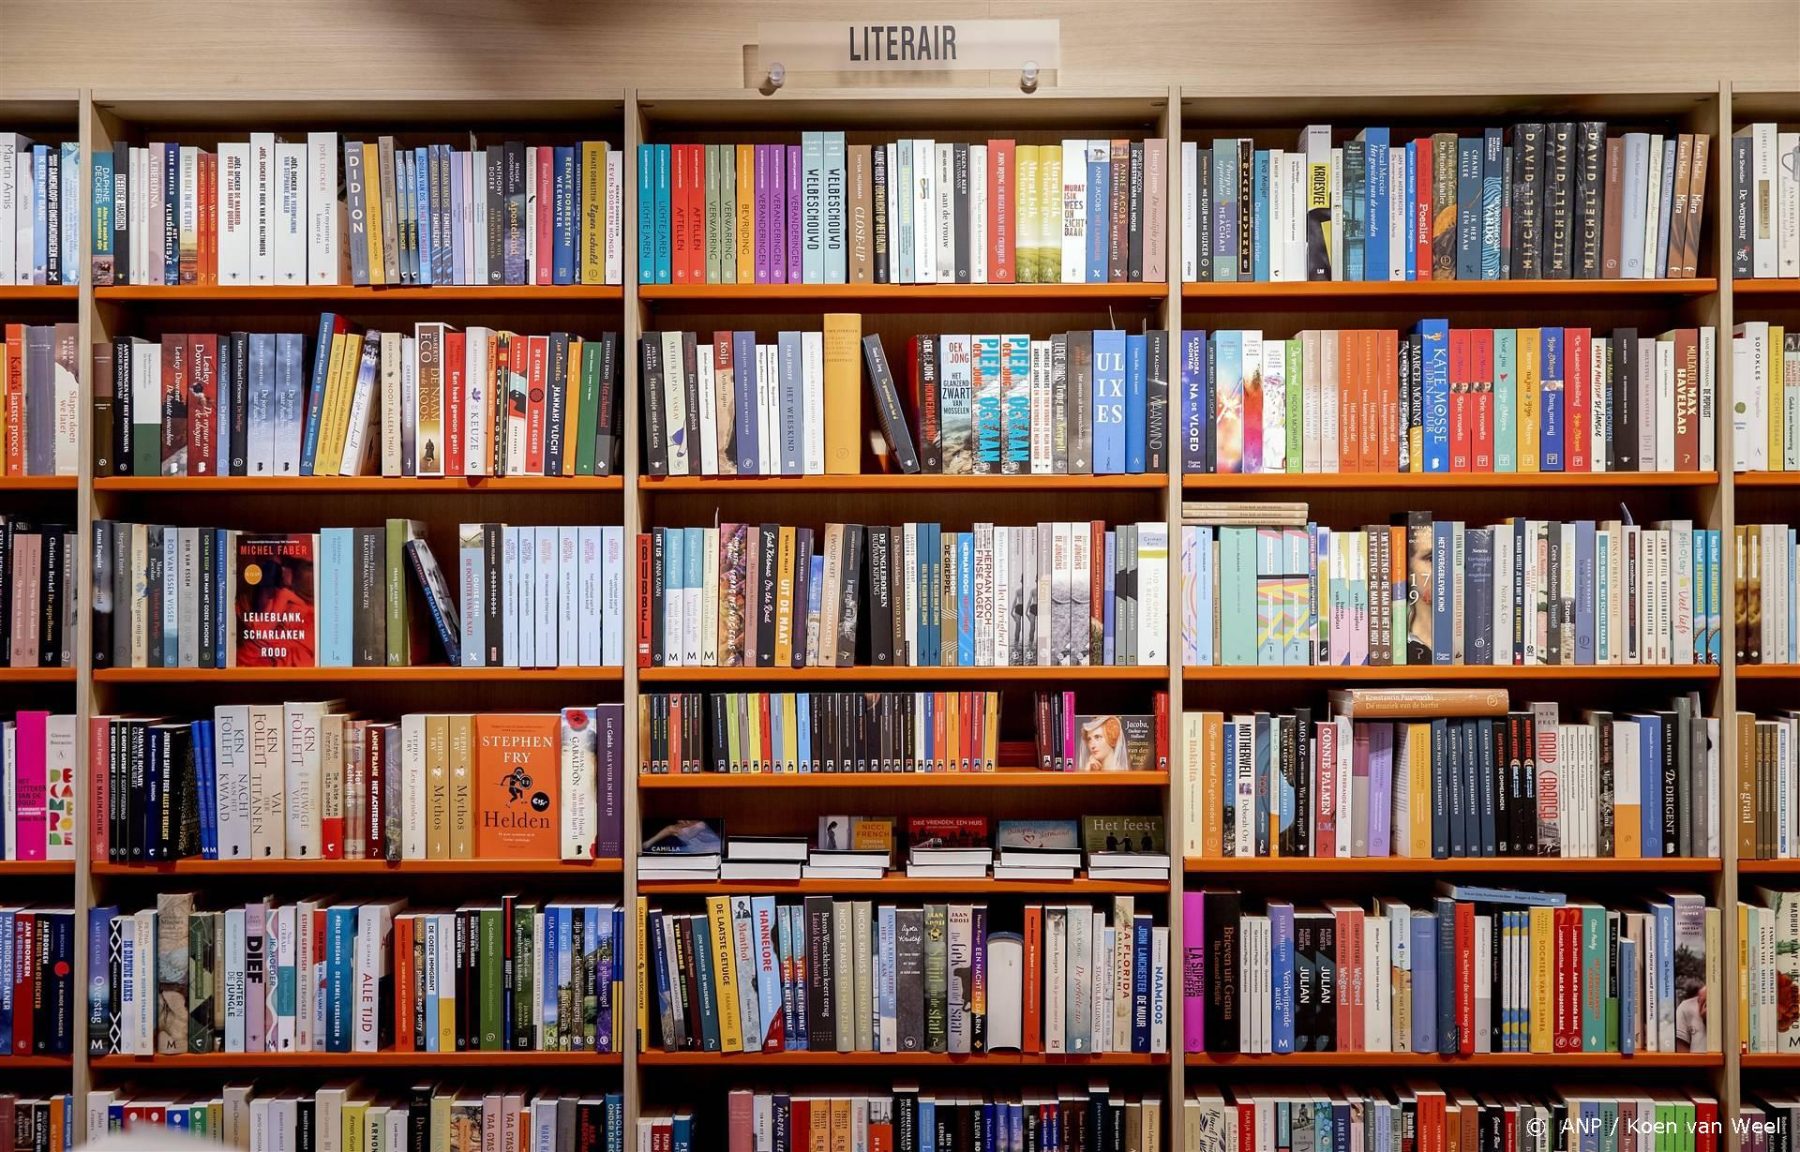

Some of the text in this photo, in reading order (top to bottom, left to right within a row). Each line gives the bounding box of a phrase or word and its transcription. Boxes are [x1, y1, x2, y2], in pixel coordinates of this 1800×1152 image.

[850, 25, 957, 61] LITERAIR
[258, 147, 266, 161] JOËL
[258, 162, 266, 181] DICKER
[95, 165, 103, 204] DECKERS
[102, 167, 110, 202] DAPHNE
[150, 154, 158, 208] ALBERDINA
[349, 156, 362, 234] DIDION
[555, 176, 564, 228] WEERWATER
[563, 157, 572, 247] RENATE DORRESTEIN
[1313, 166, 1327, 205] KROESVEE
[1523, 133, 1535, 269] DAVID MITCHELL
[1554, 132, 1567, 269] DAVID MITCHELL
[1584, 131, 1598, 269] DAVID MITCHELL
[1675, 194, 1686, 213] Mitra
[1690, 194, 1701, 213] Mitra
[709, 200, 718, 260] VERWARRING
[724, 200, 733, 260] VERWARRING
[758, 193, 767, 266] VERANDERINGEN
[773, 193, 782, 266] VERANDERINGEN
[790, 195, 800, 267] VERANDERINGEN
[806, 168, 819, 250] WELBESCHOUWD
[827, 168, 841, 250] WELBESCHOUWD
[855, 206, 865, 261] CLOSE-UP
[1419, 203, 1429, 244] Poeslief
[164, 203, 174, 265] VLINDERMEISJE
[194, 344, 204, 382] Downer
[201, 356, 213, 385] Lesley
[420, 332, 432, 363] ECO
[978, 338, 1000, 376] PIER
[1007, 338, 1029, 376] PIER
[1096, 353, 1124, 372] UL
[419, 386, 429, 421] ROOS
[430, 368, 441, 421] DE NAAM
[942, 387, 970, 399] ZWART
[1096, 379, 1124, 397] IX
[1412, 345, 1423, 426] MARCEL MÖRING
[1434, 348, 1447, 444] KATE MOSSE
[1676, 368, 1687, 435] HAVELAAR
[1687, 345, 1696, 415] MULTATULI MAX
[10, 356, 21, 456] Kafka's laatste proces
[450, 404, 458, 432] gewoon
[978, 396, 1000, 462] OCEAAN
[1007, 396, 1029, 462] OCEAAN
[1096, 404, 1122, 424] ES
[1189, 384, 1199, 451] NA DE VLOED
[451, 435, 459, 454] gezin
[470, 412, 480, 450] KEUZE
[240, 545, 307, 556] MICHEL FABER
[976, 550, 984, 618] FINSE DAGEN
[243, 611, 305, 623] LELIEBLANK,
[243, 630, 305, 640] SCHARLAKEN
[779, 579, 790, 645] UIT DE MAAT
[261, 648, 287, 657] ROOD
[221, 715, 234, 767] FOLLETT
[234, 729, 244, 753] KEN
[253, 714, 266, 768] FOLLETT
[268, 729, 278, 753] KEN
[291, 712, 304, 766] FOLLETT
[304, 726, 315, 752] KEN
[482, 736, 553, 747] STEPHEN
[503, 753, 530, 763] FRY
[571, 736, 581, 786] GABALDON
[1238, 724, 1252, 779] MOTHERWELL
[238, 773, 248, 819] NACHT
[1321, 728, 1331, 815] CONNIE PALMEN
[1539, 732, 1557, 819] MAUP CARANSA
[219, 773, 229, 822] KWAAD
[252, 774, 262, 834] TITANEN
[271, 792, 281, 816] VAL
[433, 785, 444, 831] Mythos
[456, 785, 467, 831] Mythos
[483, 811, 549, 829] Helden
[1665, 769, 1676, 835] De DIRIGENT
[1742, 782, 1754, 824] de graal
[1094, 818, 1156, 831] Het feest
[247, 935, 263, 984] DIEF
[716, 904, 730, 986] DE LAATSTE GETUIGE
[759, 910, 772, 972] HANNELORE
[821, 912, 831, 1017] Baron Wenckheim keert terug
[92, 976, 105, 1024] Overstag
[228, 972, 234, 981] DE
[1137, 926, 1147, 1027] JOHN LANCHESTER DE MUUR
[1154, 967, 1163, 1024] NAAMLOOS
[1275, 987, 1283, 1010] aarde
[1281, 970, 1291, 1027] Verdwijnende
[1300, 966, 1310, 1004] JULIAN
[1321, 966, 1331, 1004] JULIAN
[236, 1008, 243, 1017] IN
[362, 973, 373, 1032] ALLE TIJD
